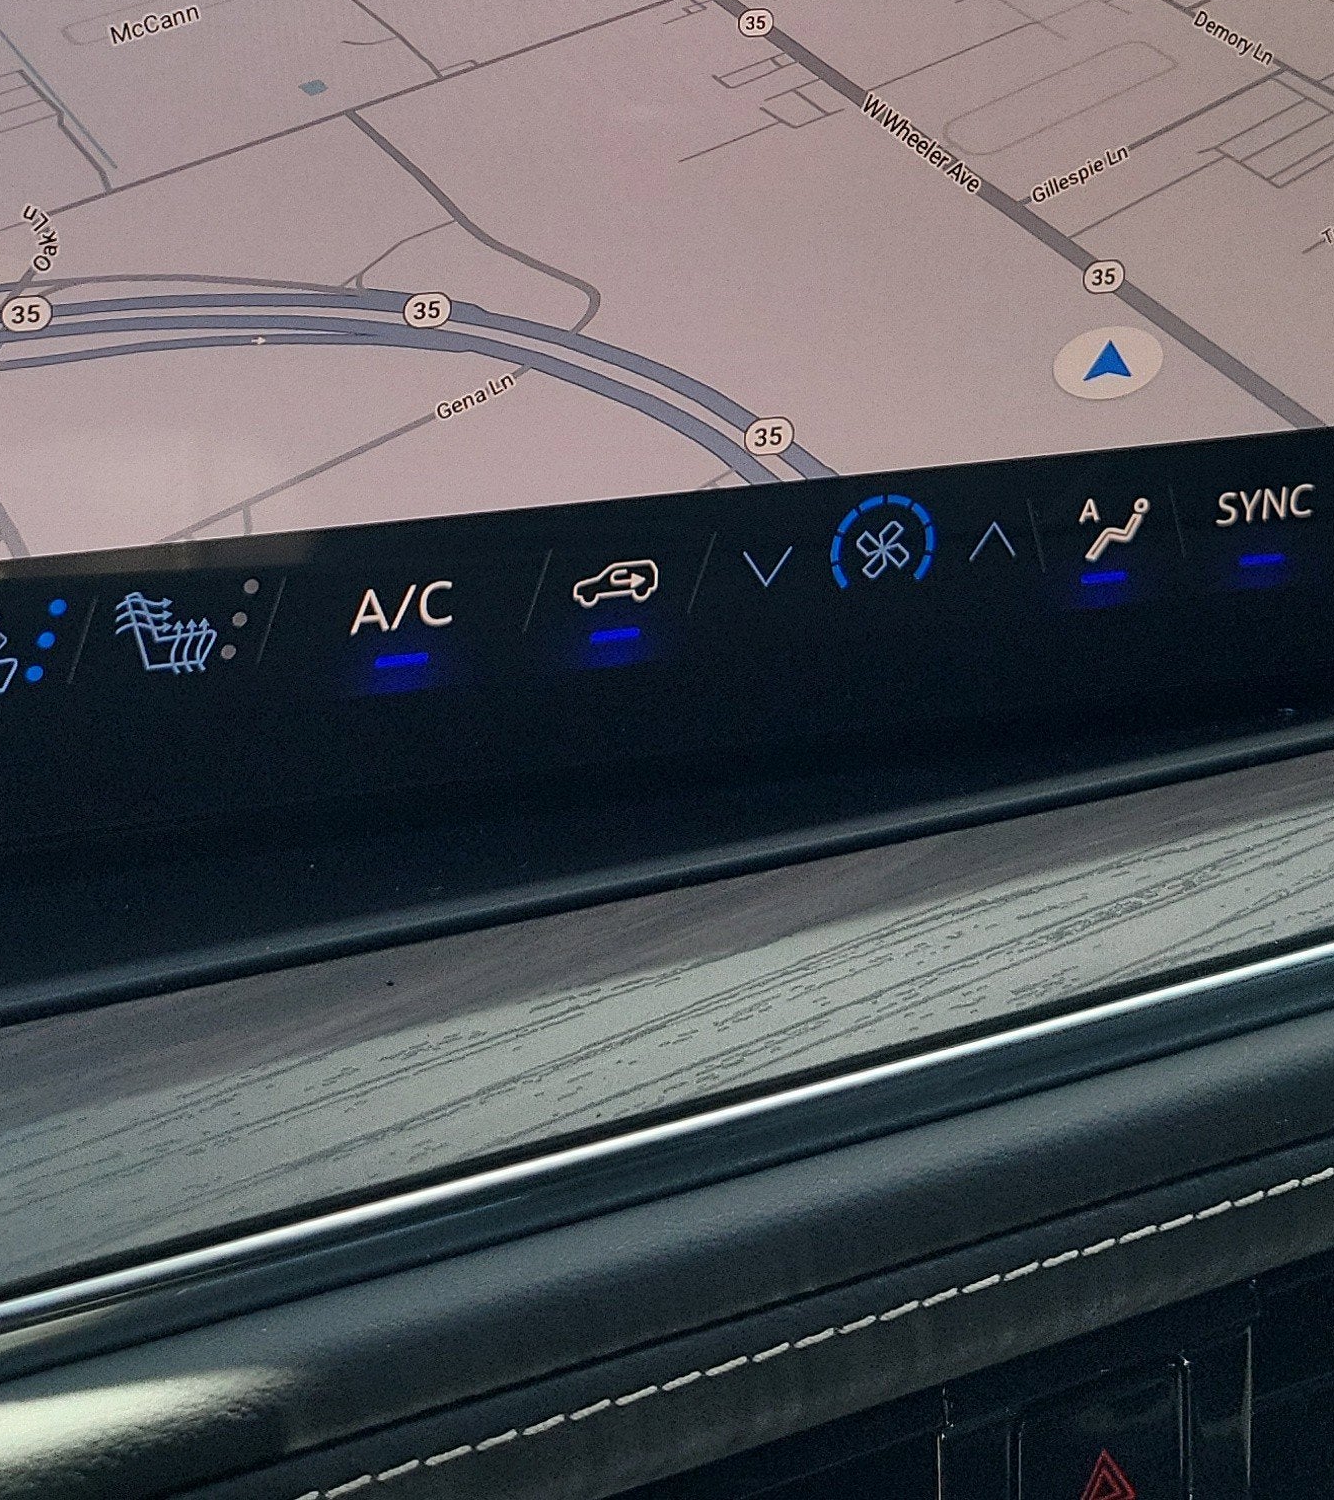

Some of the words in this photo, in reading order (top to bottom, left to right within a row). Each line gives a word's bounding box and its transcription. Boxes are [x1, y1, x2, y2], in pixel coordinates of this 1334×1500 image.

[110, 6, 199, 44] McCann
[745, 16, 766, 30] 35
[1193, 10, 1253, 55] Demory
[1253, 43, 1273, 65] Ln
[863, 94, 886, 118] W
[883, 108, 949, 168] Wheeler
[947, 162, 979, 193] Ave
[1031, 158, 1103, 204] Gillespie
[1105, 146, 1129, 166] Ln
[23, 206, 49, 231] Ln
[31, 229, 57, 271] Oak
[1092, 268, 1116, 286] 35
[12, 303, 40, 324] 35
[413, 301, 441, 320] 35
[437, 388, 487, 420] Gena
[489, 374, 513, 396] Ln
[755, 427, 783, 447] 35
[1215, 484, 1315, 527] SYNC
[350, 580, 453, 636] A/C
